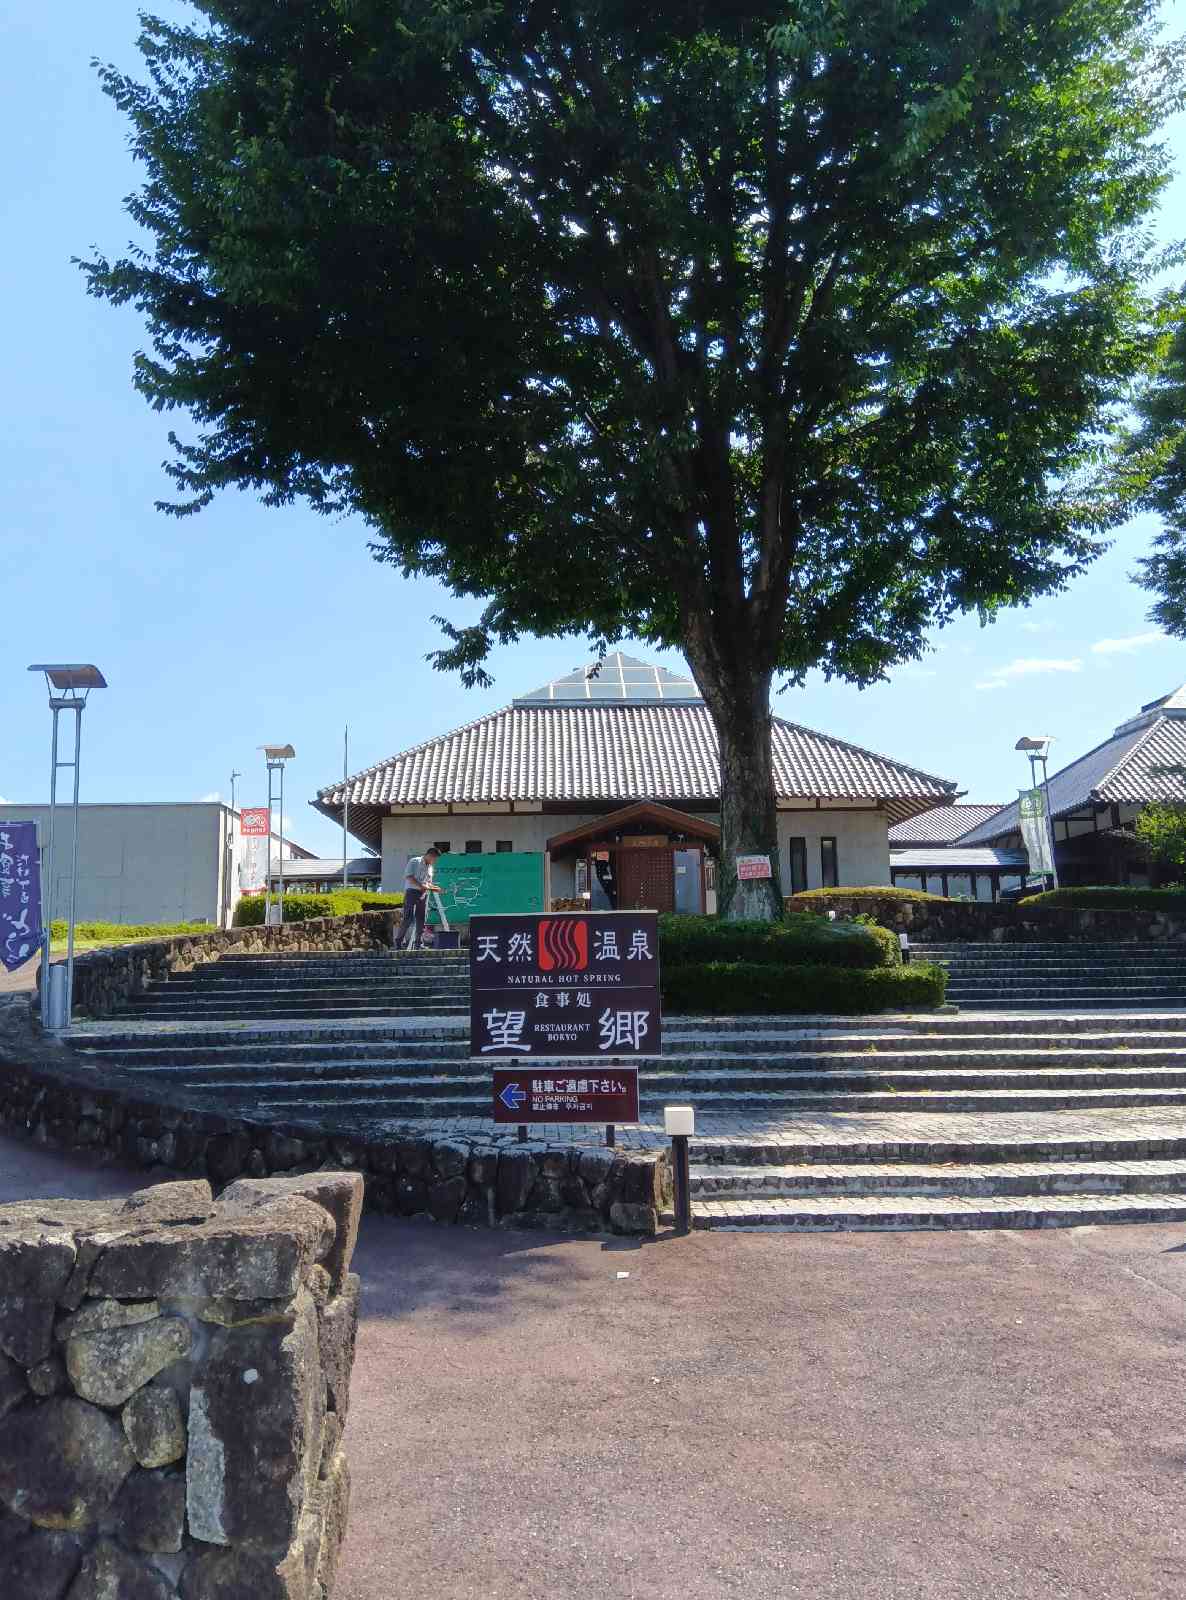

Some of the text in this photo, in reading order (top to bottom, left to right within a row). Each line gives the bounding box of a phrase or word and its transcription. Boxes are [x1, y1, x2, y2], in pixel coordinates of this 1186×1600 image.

[476, 930, 653, 962] 天然 温泉
[507, 973, 621, 984] NATURAL HOT SPRING
[535, 991, 592, 1008] 食事処
[480, 1007, 650, 1052] 望 郷
[534, 1023, 591, 1032] RESTAURANT
[532, 1095, 578, 1103] NO PARKING
